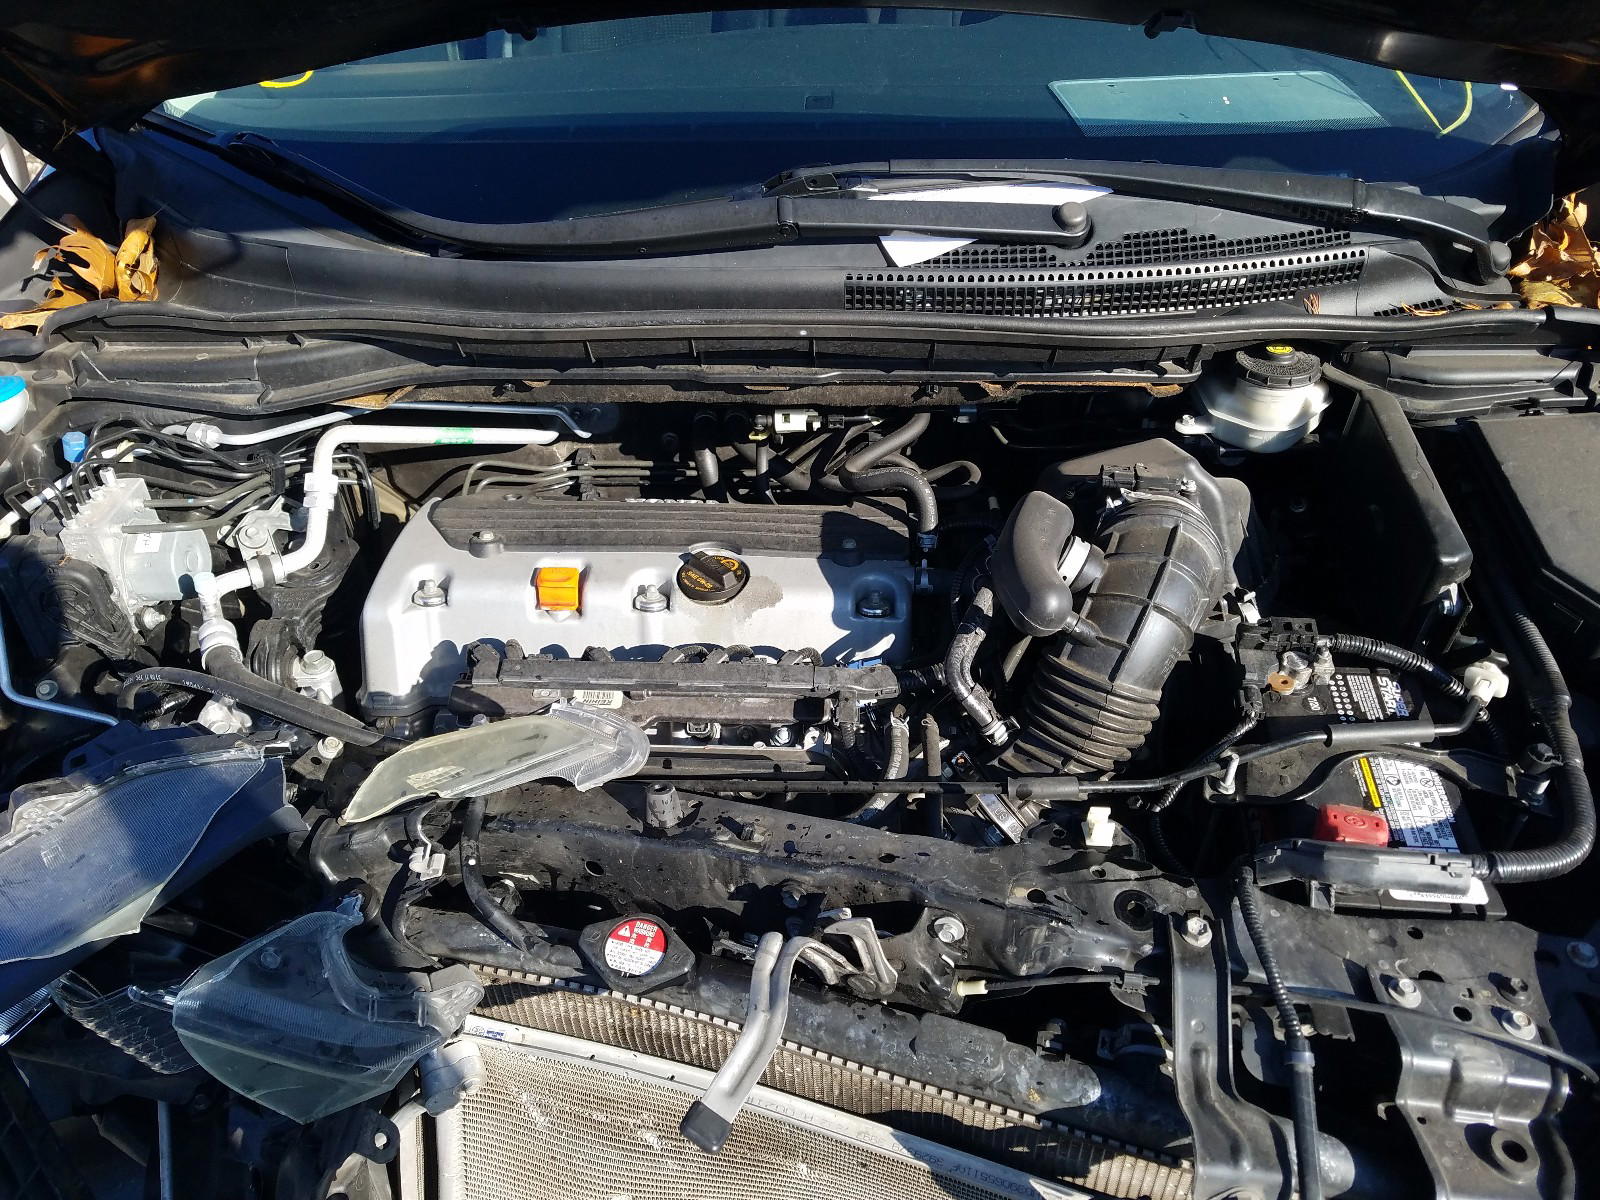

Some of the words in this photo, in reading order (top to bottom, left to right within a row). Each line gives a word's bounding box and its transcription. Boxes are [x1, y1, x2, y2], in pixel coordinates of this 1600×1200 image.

[1376, 675, 1396, 715] START
[1392, 680, 1410, 718] SUPER
[635, 921, 658, 932] DANGER
